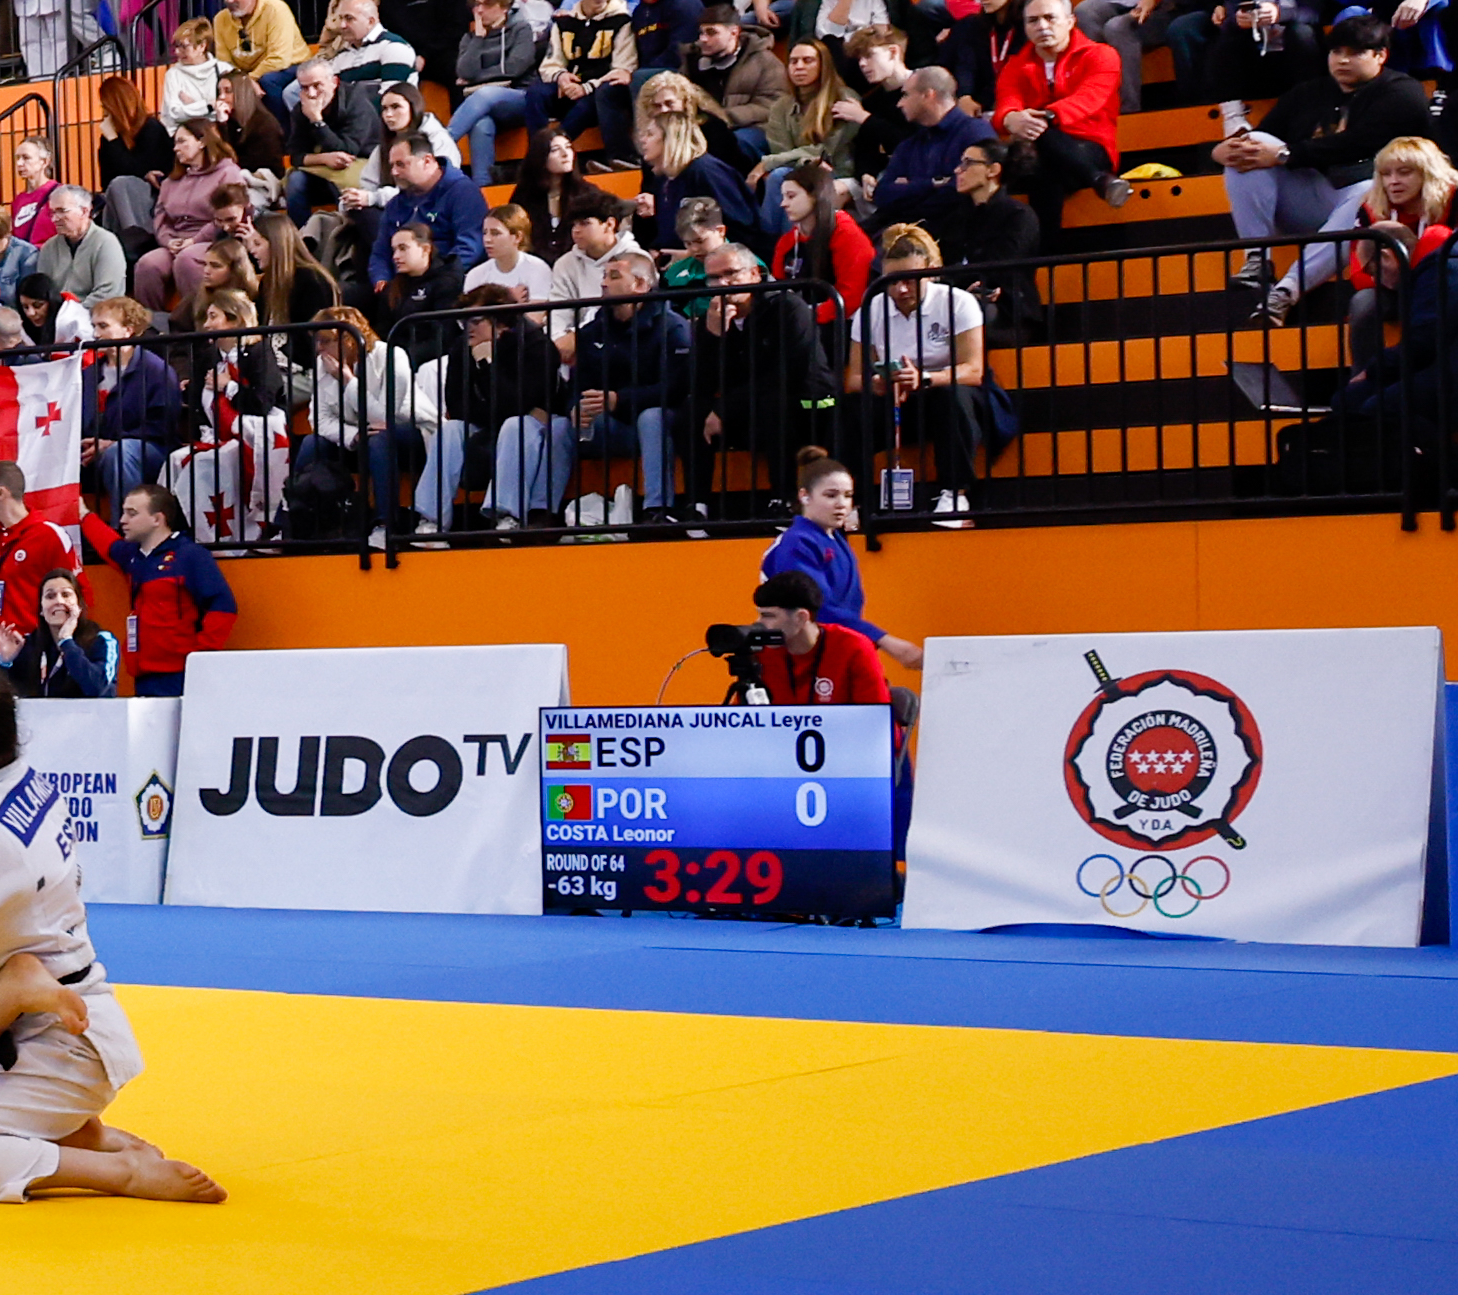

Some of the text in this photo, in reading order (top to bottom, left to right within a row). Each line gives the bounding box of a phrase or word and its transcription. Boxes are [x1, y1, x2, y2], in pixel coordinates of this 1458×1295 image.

[545, 712, 823, 731] VILLAMEDIANA JUNCAL Leyre
[596, 729, 827, 773] ESP 0
[1109, 713, 1218, 779] FEDERACIÓN MADRILEÑA
[199, 732, 533, 818] JUDO TV
[596, 781, 828, 827] POR 0
[1127, 789, 1192, 810] DE JUDO
[546, 824, 676, 843] COSTA Leonor
[1139, 819, 1149, 831] Y
[546, 854, 625, 872] ROUND OF 64
[547, 849, 785, 906] -63 kg 3:29
